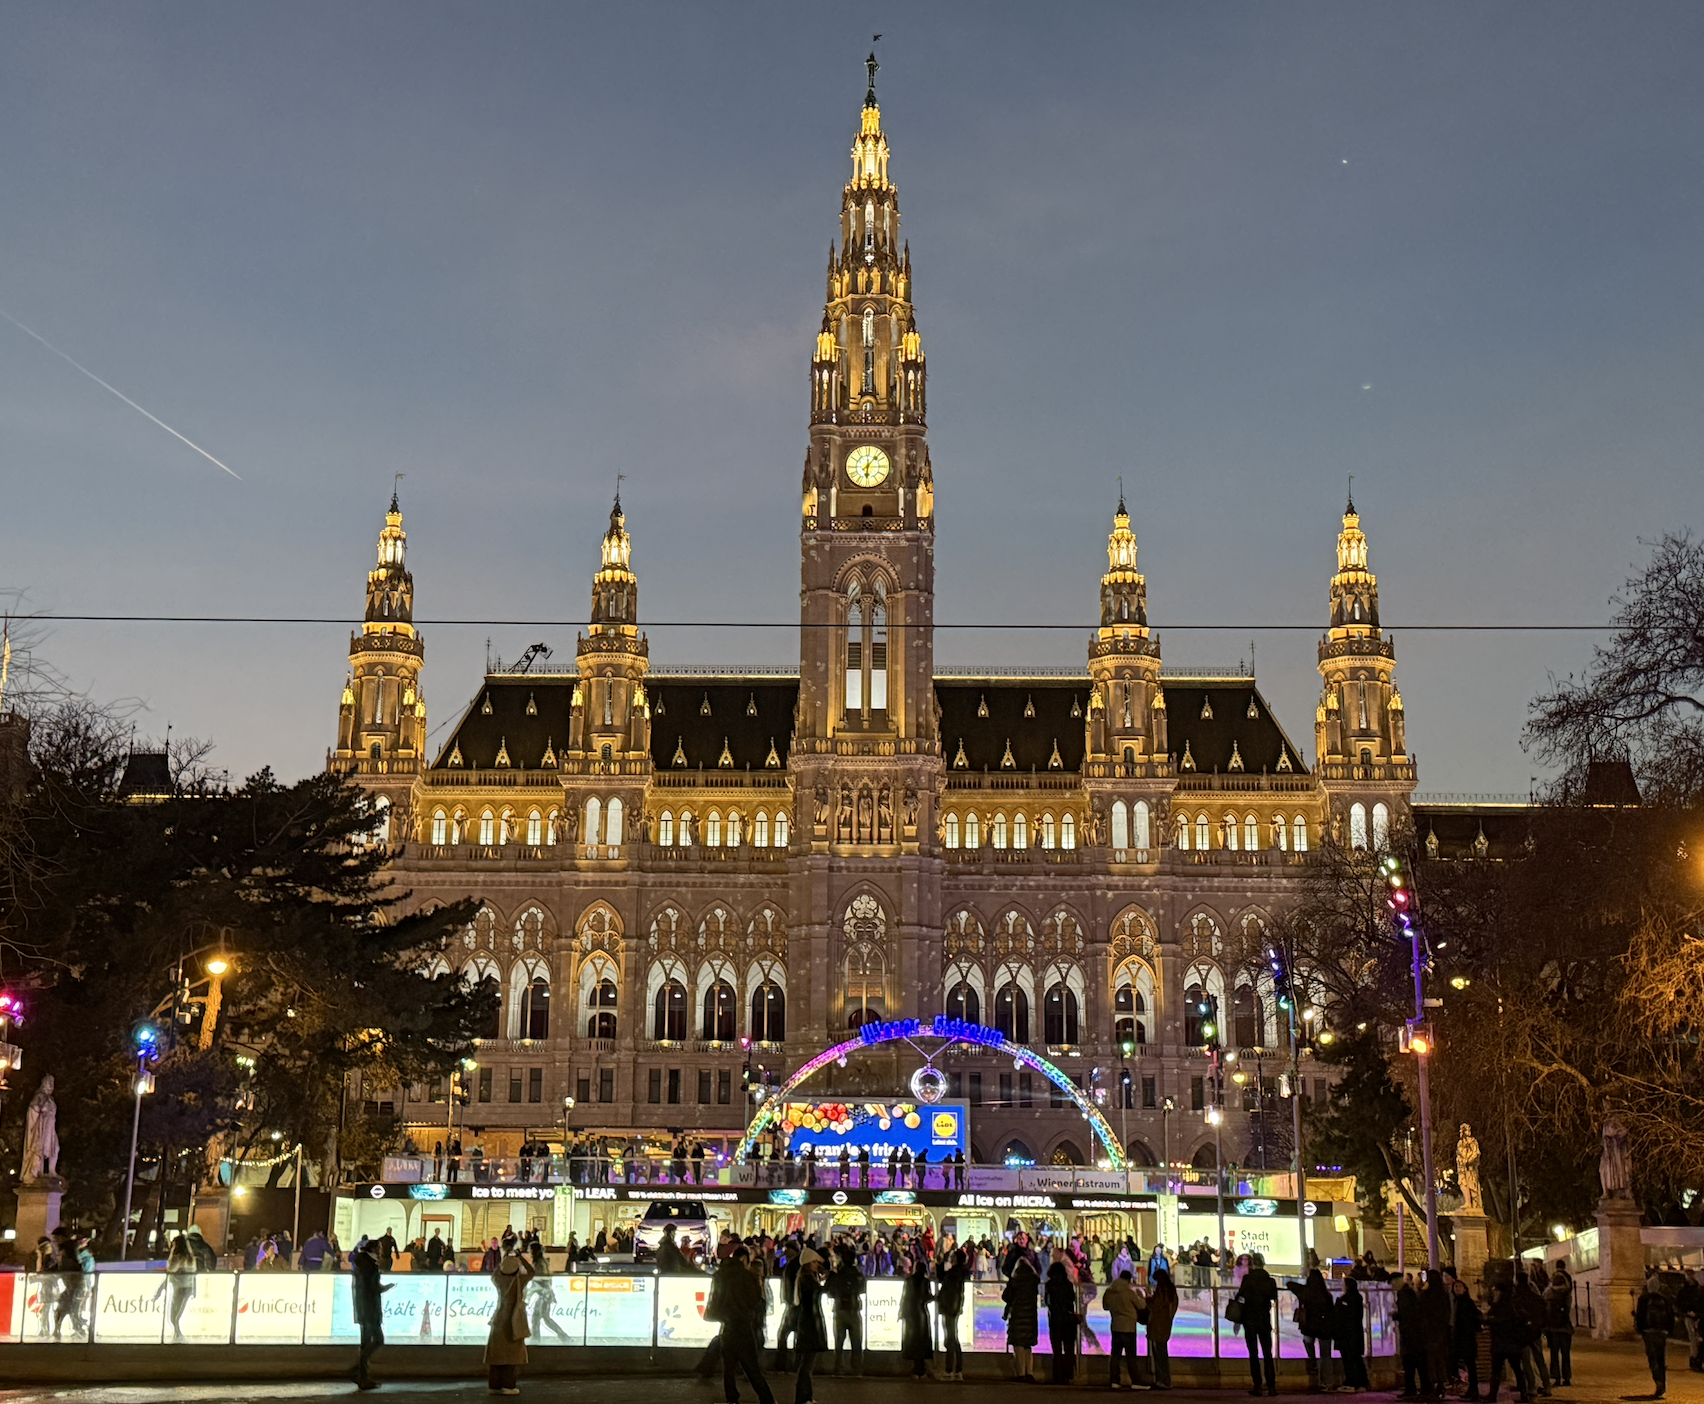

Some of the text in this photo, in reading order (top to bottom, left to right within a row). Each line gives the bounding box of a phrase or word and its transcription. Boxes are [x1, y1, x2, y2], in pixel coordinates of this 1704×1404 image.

[1037, 1178, 1072, 1188] Wiener
[472, 1186, 489, 1198] Ice
[490, 1186, 505, 1198] to
[506, 1186, 538, 1198] meet
[538, 1187, 555, 1200] yo
[995, 1196, 1012, 1207] on
[1241, 1230, 1269, 1241] Stadt
[449, 1299, 495, 1318] Stadt
